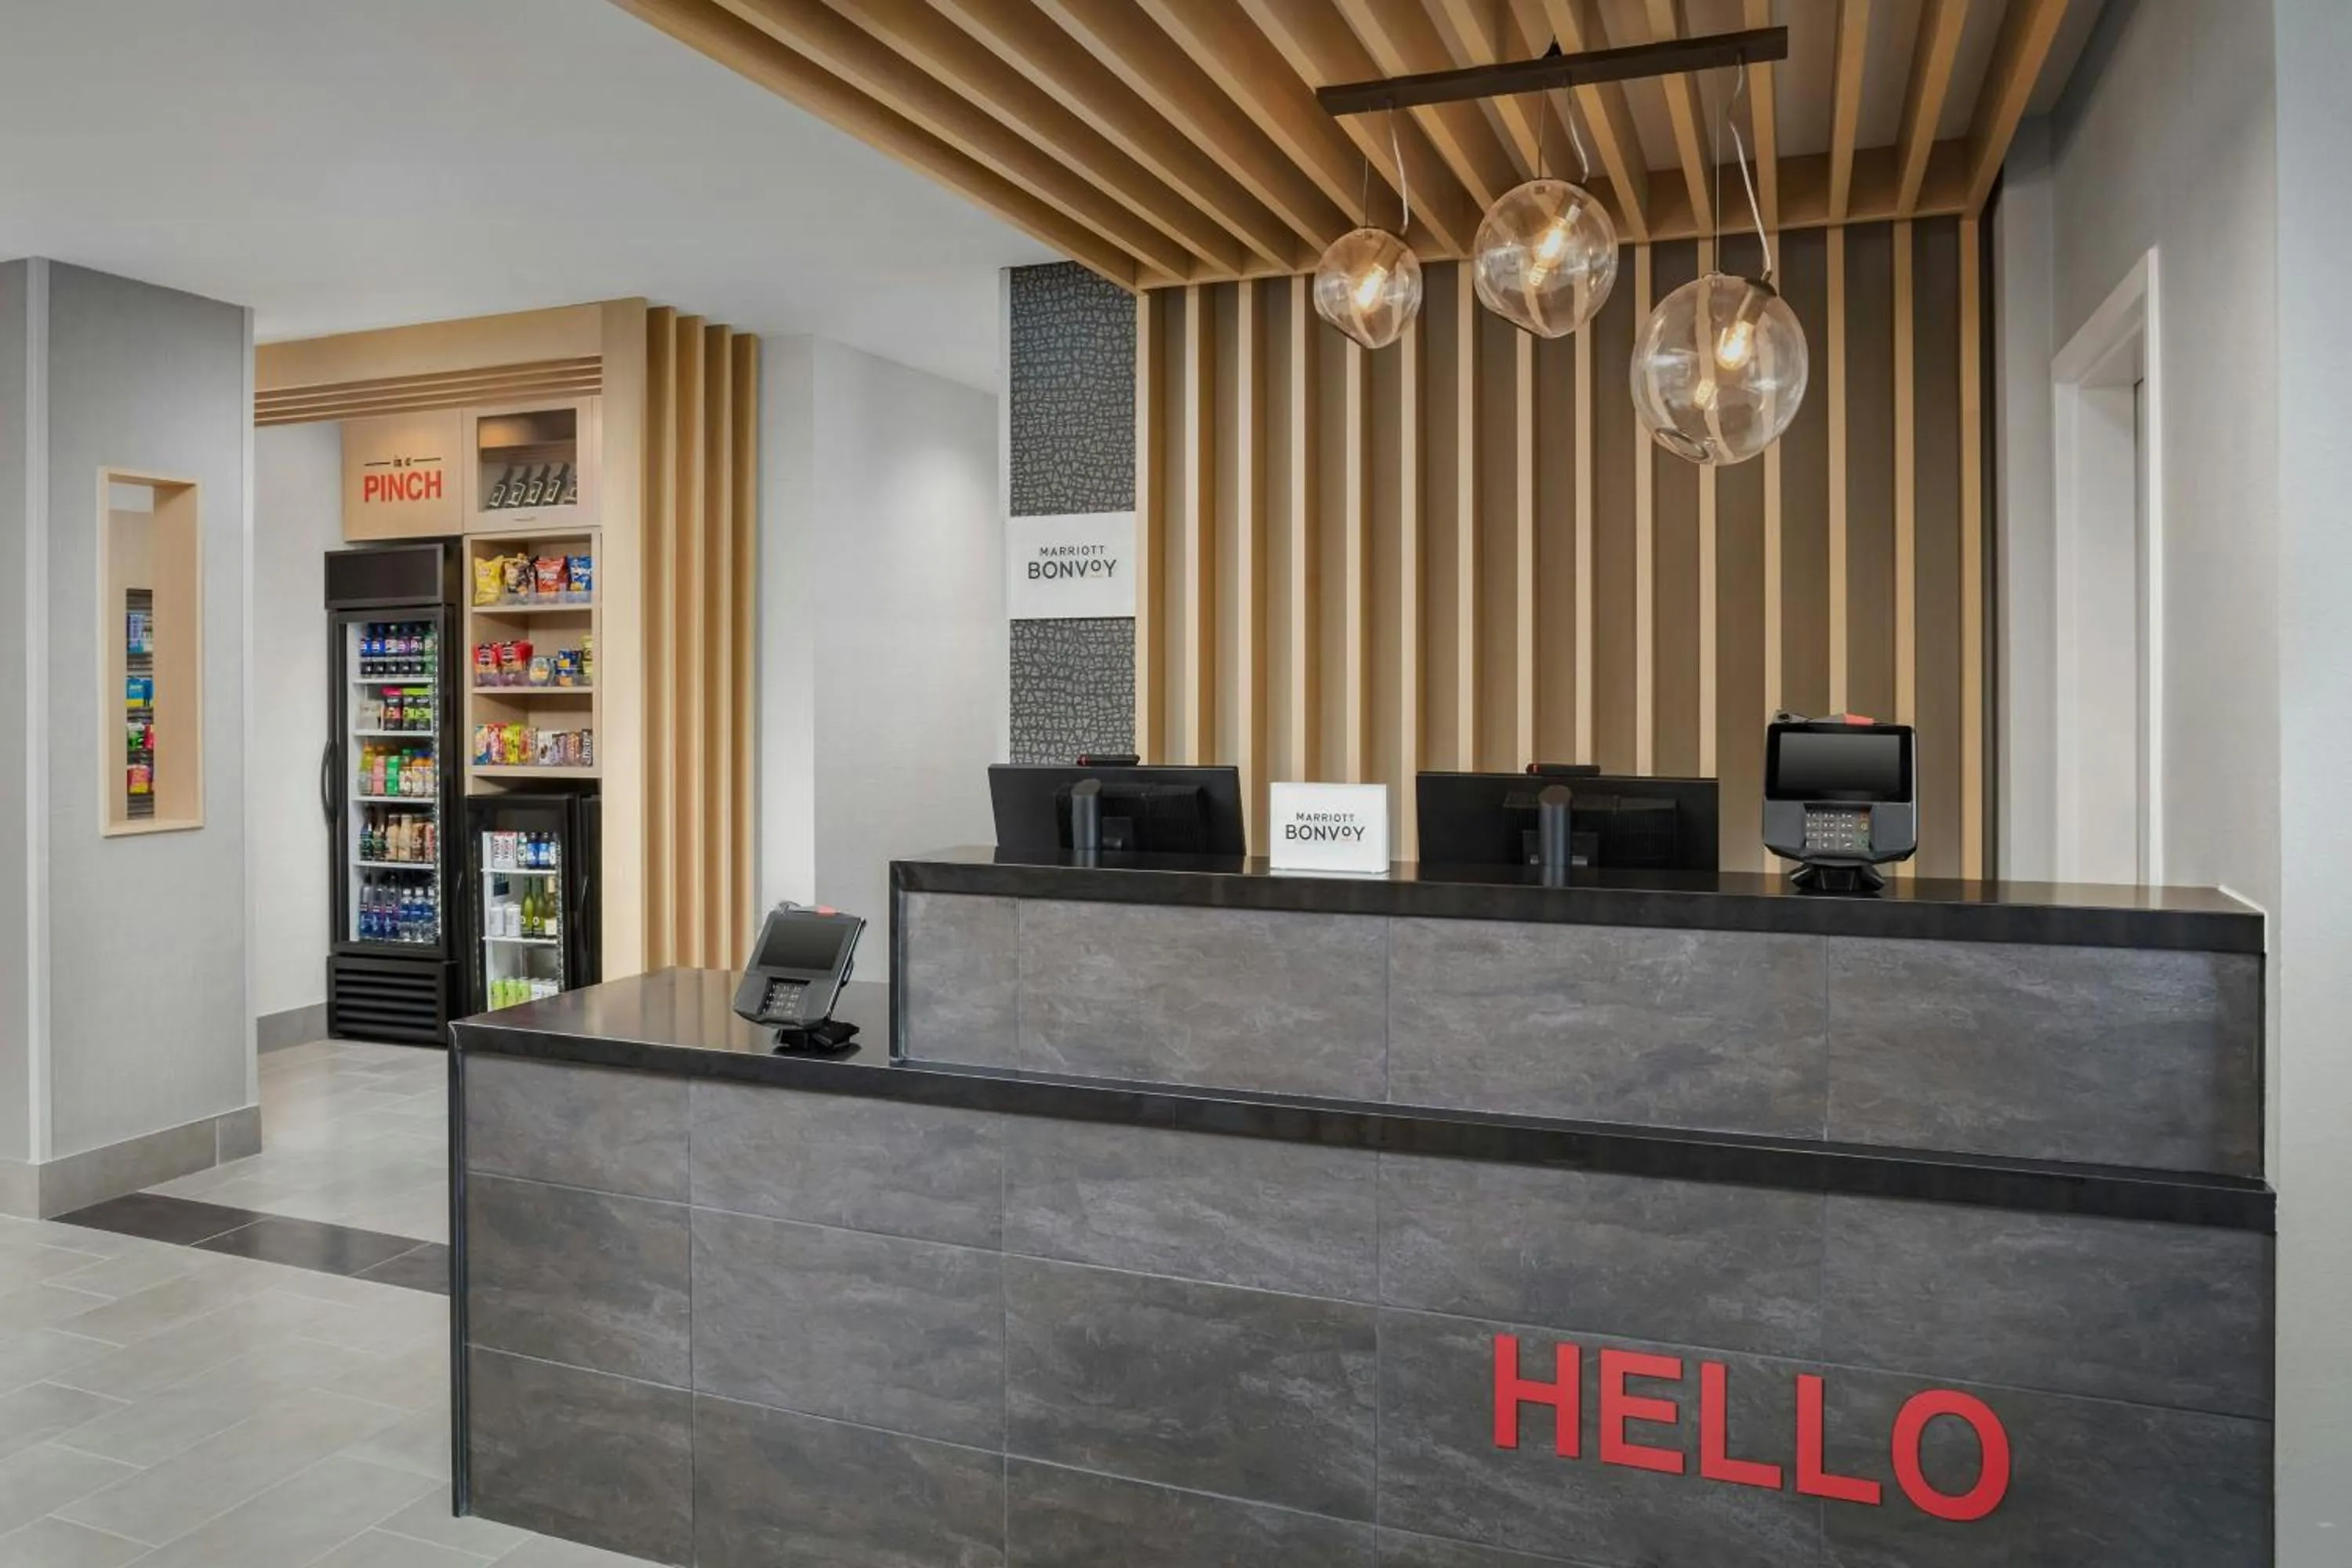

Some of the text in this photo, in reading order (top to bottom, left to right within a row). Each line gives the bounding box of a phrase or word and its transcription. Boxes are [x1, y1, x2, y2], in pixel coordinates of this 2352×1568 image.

[364, 470, 441, 503] PINCH
[1040, 545, 1105, 556] MARRIOTT
[1028, 559, 1116, 579] BONVOY
[1296, 812, 1356, 822] MARRIOTT
[1286, 824, 1366, 840] BONVOY
[1494, 1332, 2010, 1521] HELLO
